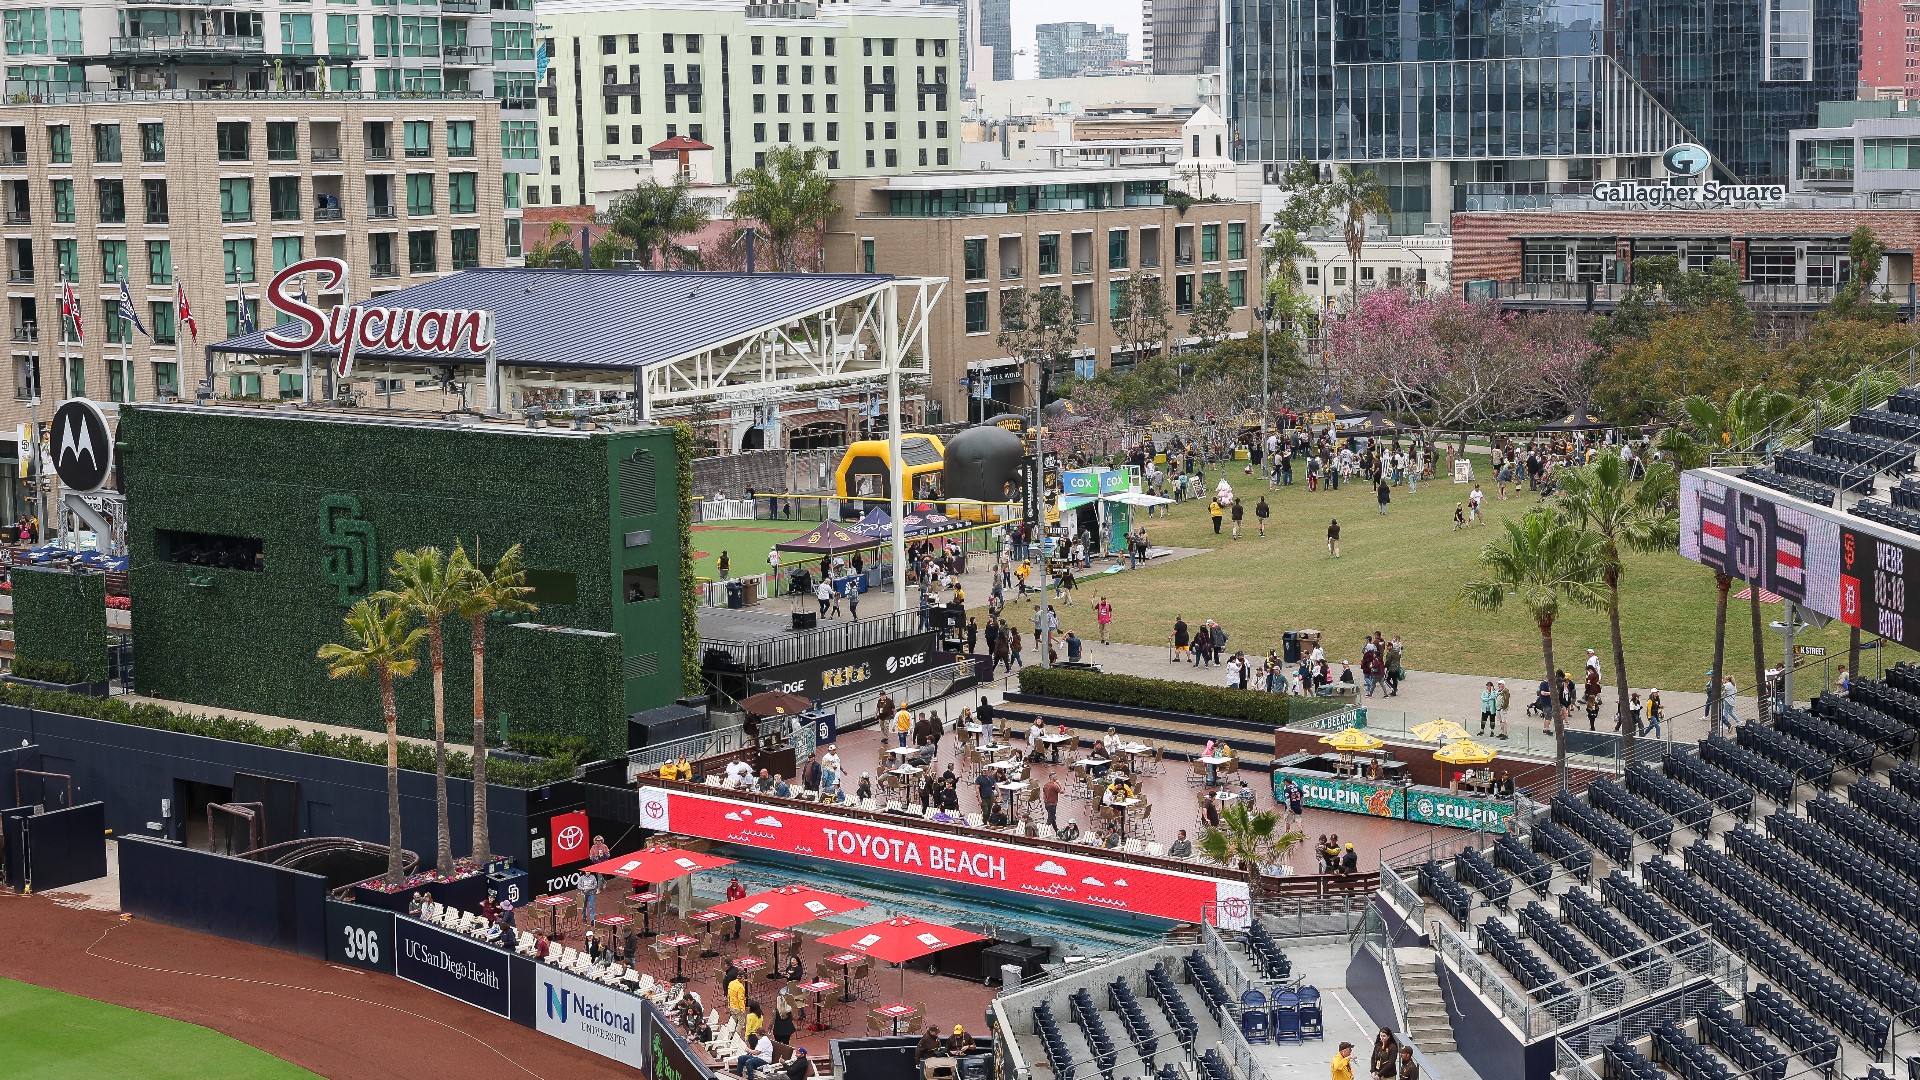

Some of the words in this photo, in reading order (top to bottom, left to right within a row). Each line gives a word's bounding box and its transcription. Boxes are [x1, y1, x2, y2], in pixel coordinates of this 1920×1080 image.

[1592, 182, 1699, 206] Gallagher
[1703, 182, 1782, 206] Square
[264, 257, 496, 378] Sycuan
[1070, 478, 1092, 488] COX
[1106, 476, 1123, 487] COX
[1876, 541, 1903, 575] WEBB
[1873, 570, 1905, 612] 10:10
[1878, 607, 1903, 642] BOYD
[899, 652, 925, 668] SDGE
[1805, 647, 1825, 656] STREET
[782, 681, 805, 694] DGE
[1327, 713, 1345, 729] BEER
[1346, 709, 1357, 723] ON
[1302, 785, 1361, 805] SCULPIN
[1436, 804, 1498, 825] SCULPIN
[822, 827, 922, 867] TOYOTA
[929, 845, 1006, 881] BEACH
[546, 872, 581, 892] TOYO
[344, 925, 379, 964] 396
[405, 938, 421, 961] UC
[421, 944, 440, 968] San
[439, 950, 467, 980] Diego
[467, 960, 500, 990] Health
[573, 992, 635, 1035] National
[580, 1021, 627, 1047] UNIVERSITY
